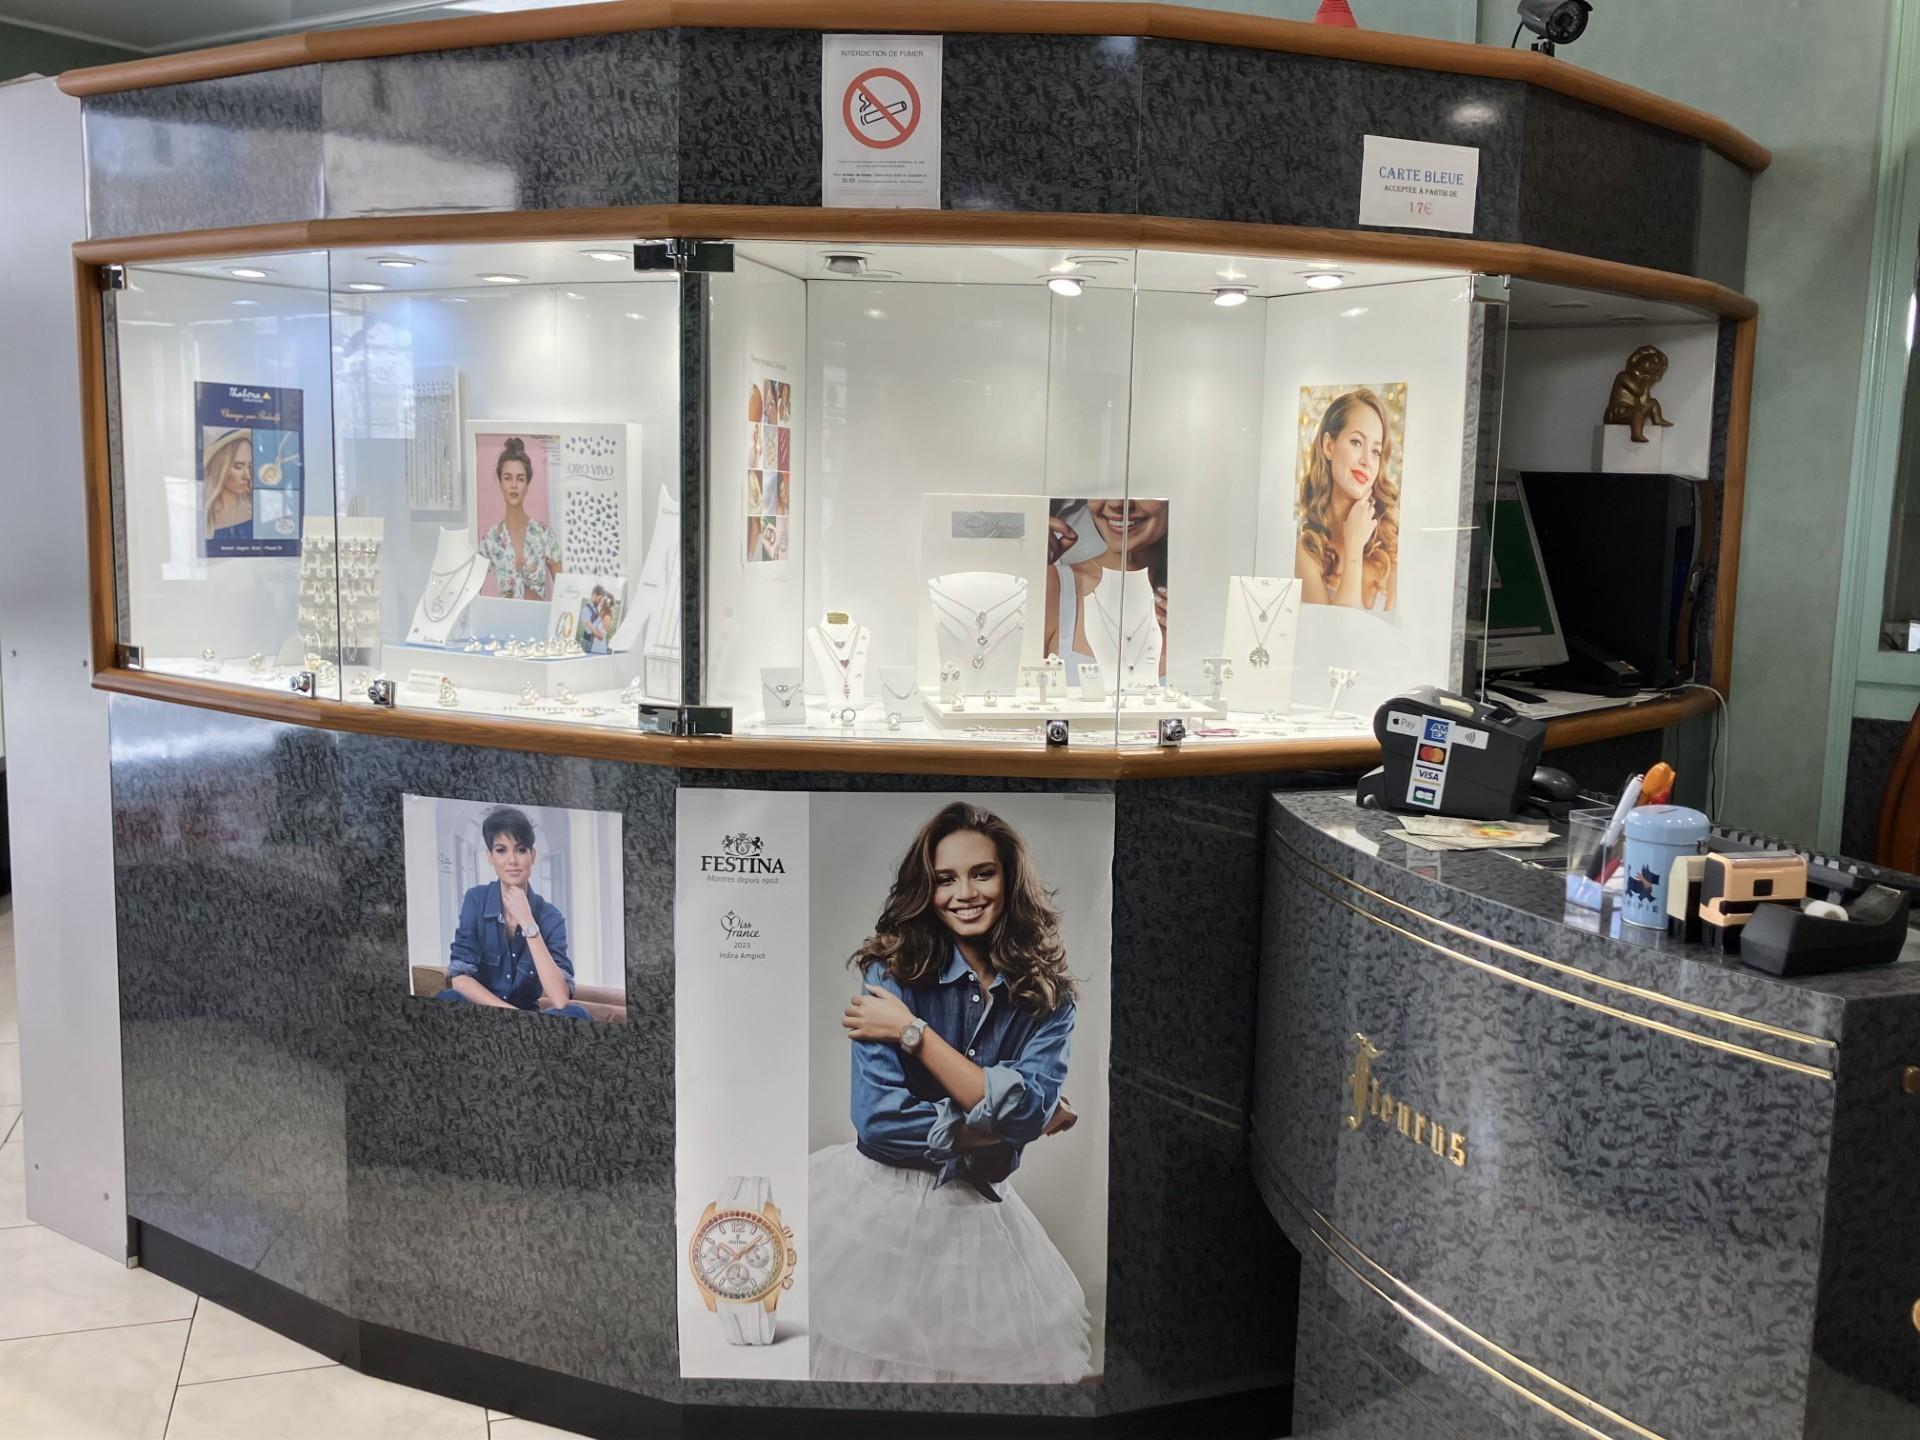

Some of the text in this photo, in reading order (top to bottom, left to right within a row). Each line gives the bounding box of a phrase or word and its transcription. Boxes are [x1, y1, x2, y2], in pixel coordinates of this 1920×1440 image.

[1379, 166, 1464, 186] CARTE BLEUE
[1425, 188, 1448, 196] PARTIR
[1400, 718, 1416, 730] Pay
[1419, 769, 1440, 782] VISA
[701, 855, 786, 874] FESTINA
[706, 874, 736, 883] Montres
[737, 876, 760, 884] depuis
[740, 952, 766, 960] Ampiot
